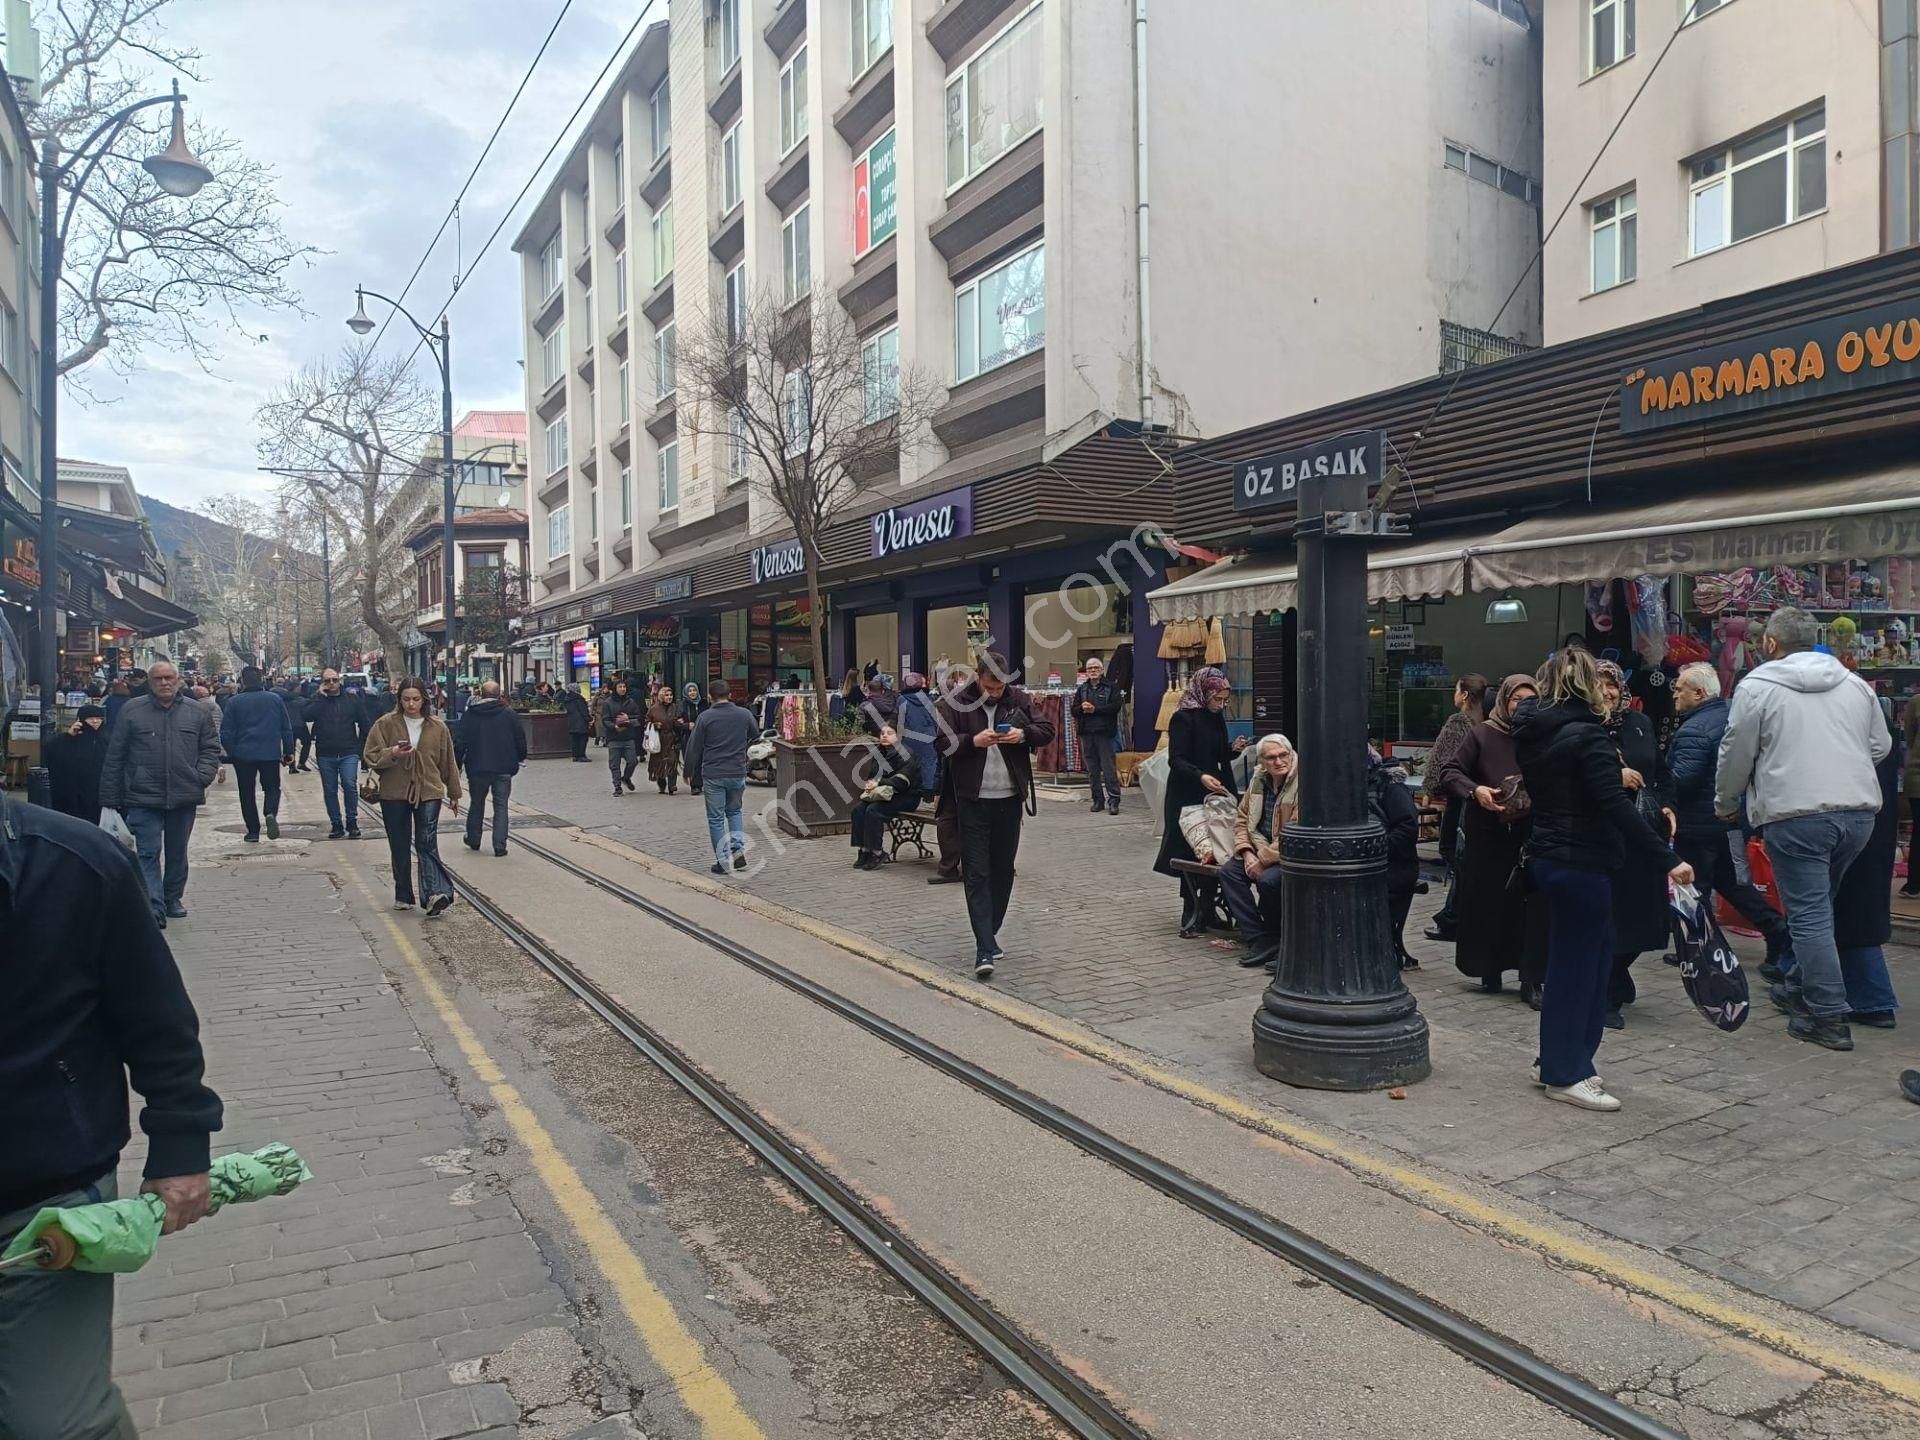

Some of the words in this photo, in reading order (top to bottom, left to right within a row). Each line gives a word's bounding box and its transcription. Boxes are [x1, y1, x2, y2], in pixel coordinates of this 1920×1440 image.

[1641, 341, 1825, 415] MARMARA
[1836, 317, 1920, 373] OYU
[1244, 466, 1274, 498] ÖZ
[875, 504, 954, 556] Venesa
[1646, 536, 1694, 565] ES
[1712, 524, 1841, 561] Marmara
[752, 547, 805, 583] Venesa
